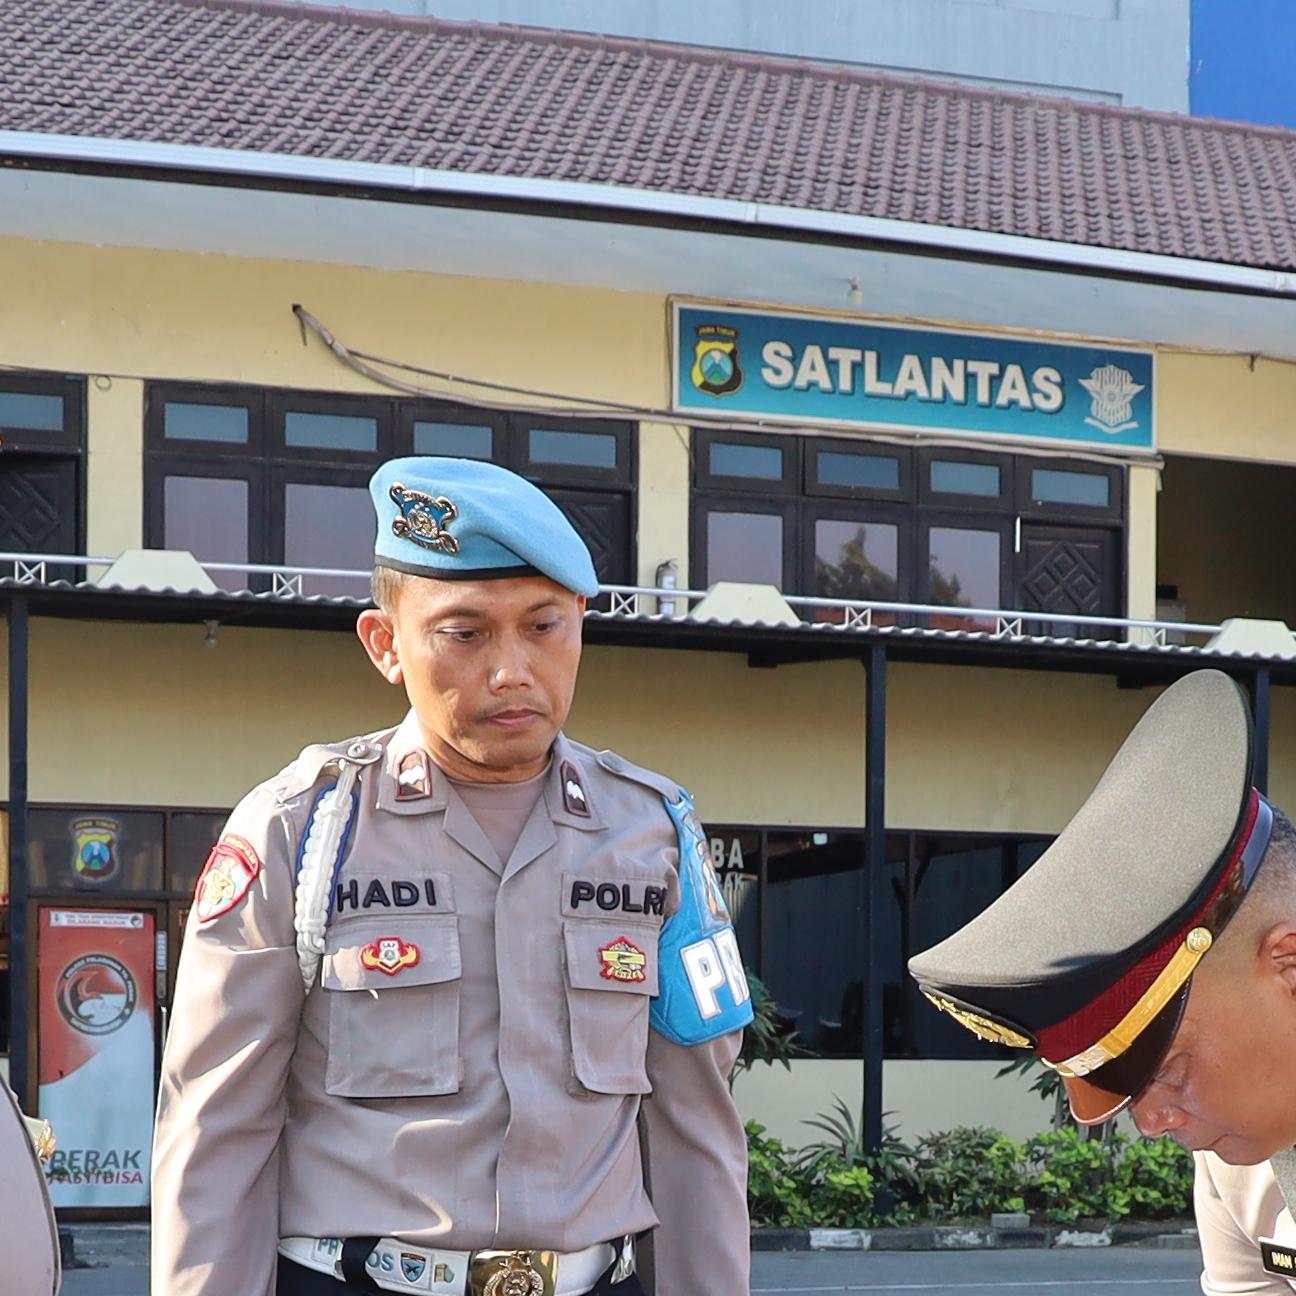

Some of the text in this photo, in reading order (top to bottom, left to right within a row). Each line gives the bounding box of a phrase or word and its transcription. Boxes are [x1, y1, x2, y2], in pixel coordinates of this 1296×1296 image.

[761, 340, 1065, 414] SATLANTAS
[337, 879, 437, 912] HADI
[570, 881, 667, 916] POLRI
[48, 1149, 143, 1173] PERAK
